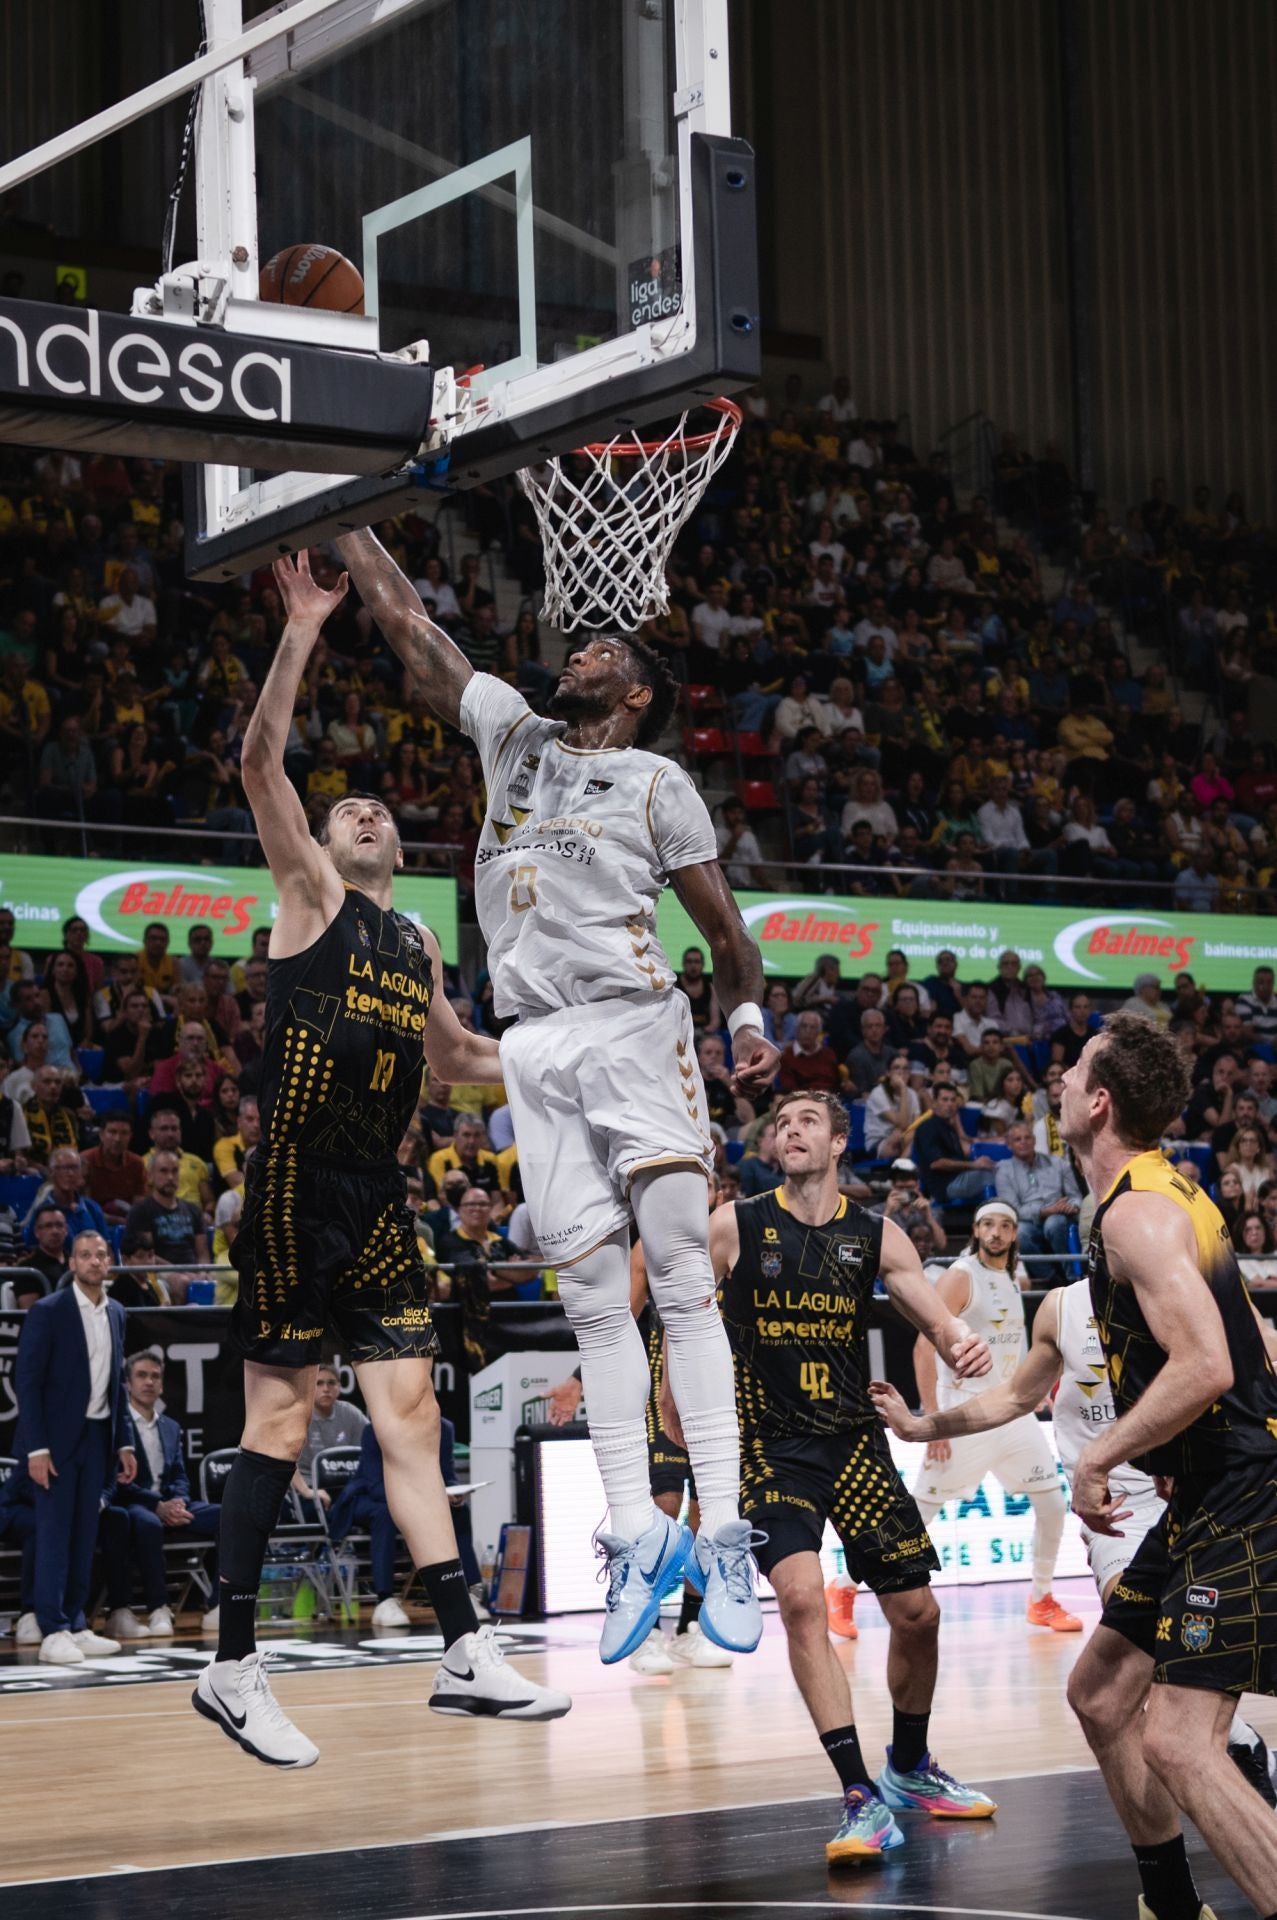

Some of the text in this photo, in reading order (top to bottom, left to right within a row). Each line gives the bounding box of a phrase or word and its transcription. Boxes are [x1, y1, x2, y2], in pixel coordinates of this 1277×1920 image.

[631, 279, 658, 305] liga
[632, 293, 684, 326] endes
[119, 882, 259, 935] Balmes
[761, 911, 880, 958] Balmes
[892, 919, 998, 942] Equipamiento y
[969, 944, 986, 959] de
[989, 946, 1043, 961] ofinas
[1087, 927, 1196, 972] Balmes
[349, 954, 430, 1008] LA AGUNA
[754, 1289, 856, 1316] LA LAGUNA
[800, 1362, 835, 1401] 42
[1189, 1592, 1212, 1604] acb
